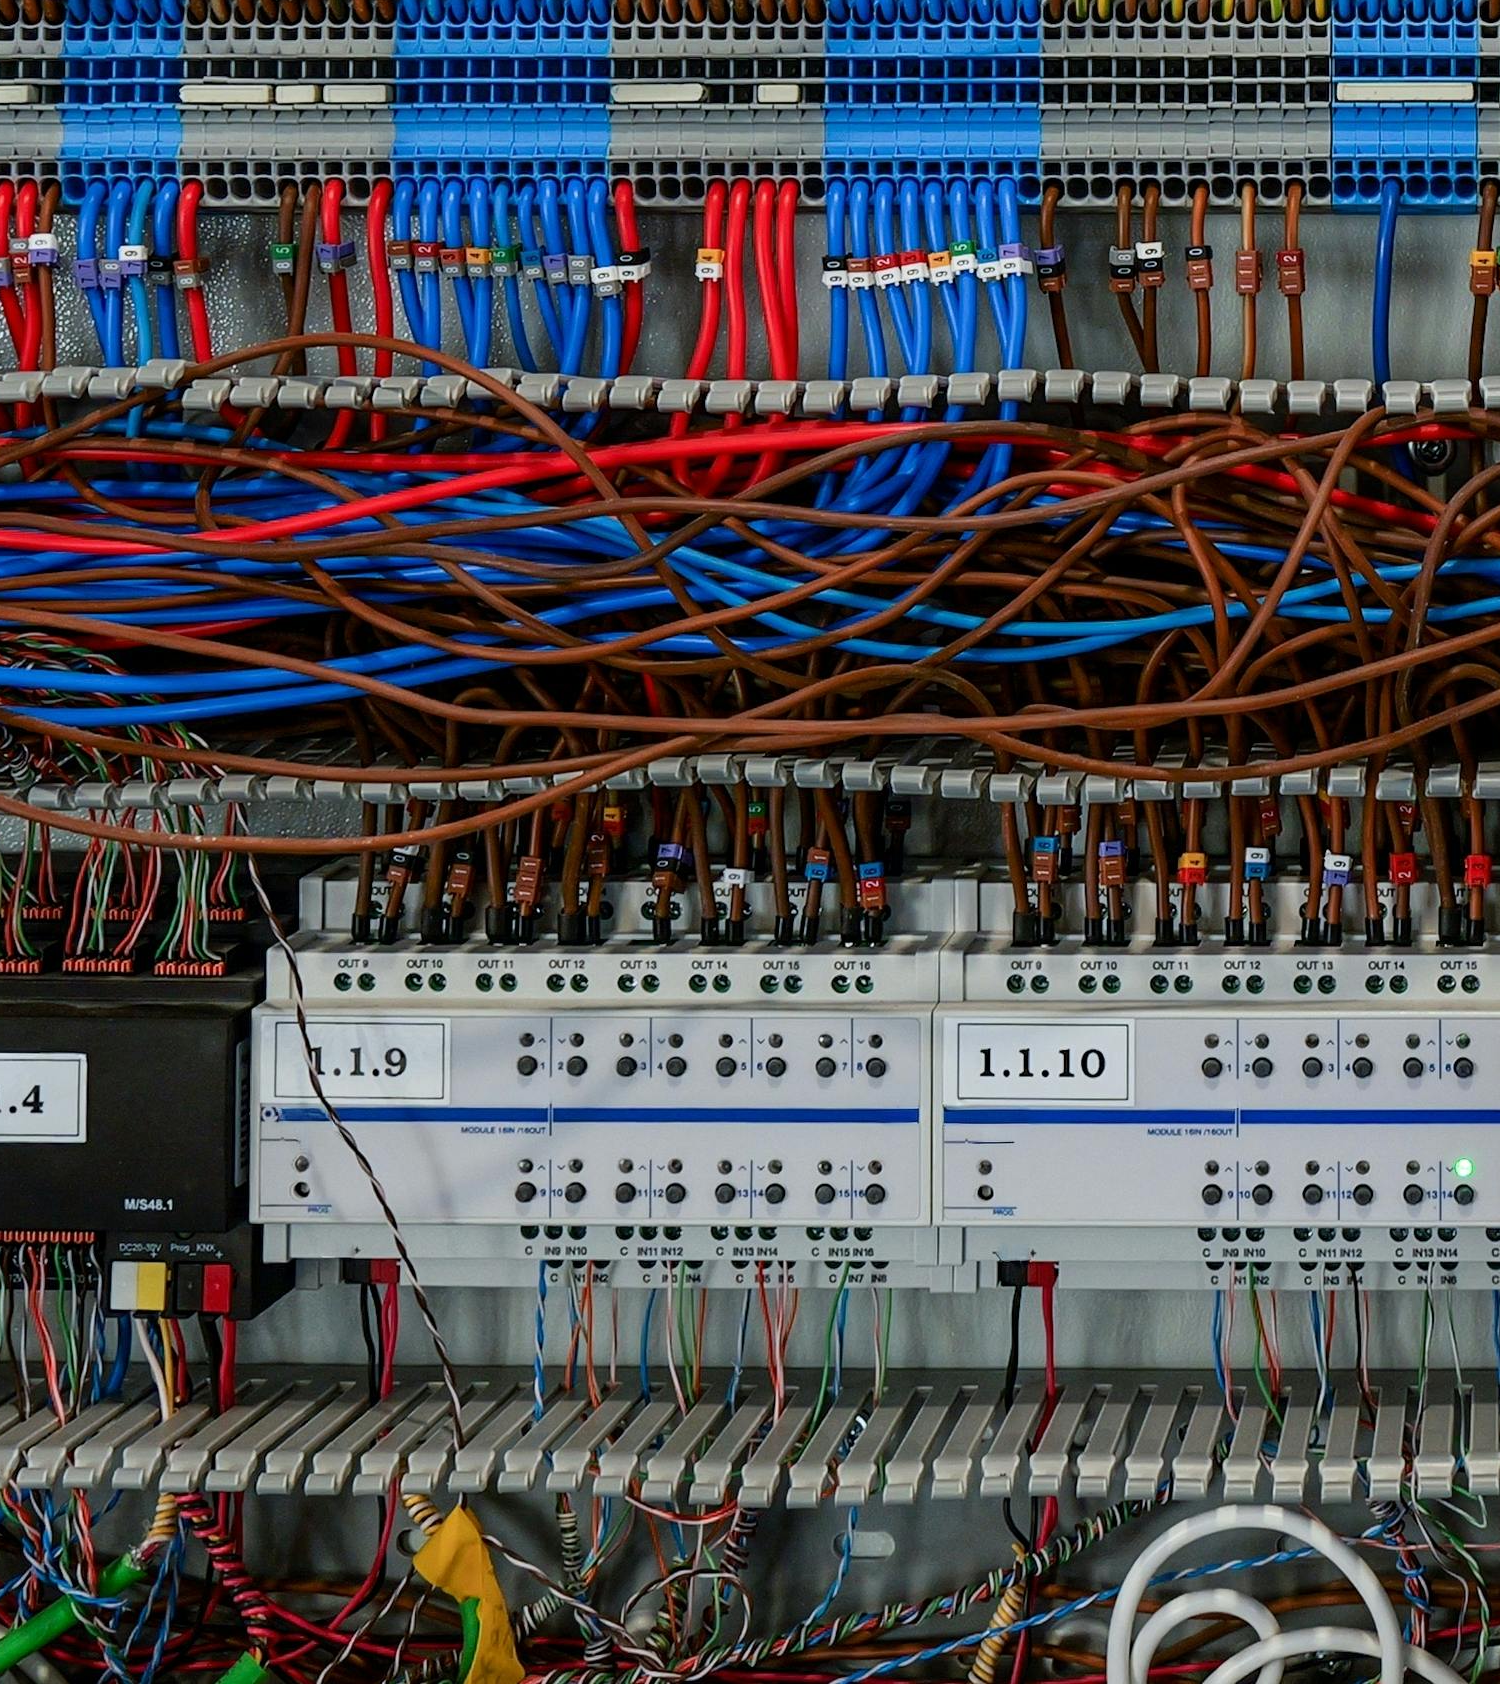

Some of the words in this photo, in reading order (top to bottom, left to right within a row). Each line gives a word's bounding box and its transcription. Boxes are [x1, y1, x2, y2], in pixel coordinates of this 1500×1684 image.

[338, 959, 360, 968] OUT
[363, 960, 369, 968] 9
[407, 959, 429, 968] OUT
[432, 959, 443, 968] 10
[478, 959, 500, 969] OUT
[504, 960, 513, 968] 11
[549, 959, 571, 969] OUT
[574, 960, 585, 969] 12
[620, 960, 643, 969] OUT
[646, 961, 657, 969] 13
[692, 961, 713, 969] OUT
[717, 961, 727, 969] 14
[763, 961, 785, 970] OUT
[788, 961, 800, 970] 15
[834, 961, 856, 970] OUT
[860, 961, 870, 970] 16
[1011, 961, 1033, 970] OUT
[1036, 961, 1041, 970] 9
[1081, 961, 1102, 970] OUT
[1106, 961, 1117, 970] 10
[1153, 961, 1175, 970] OUT
[1224, 961, 1246, 969] OUT
[1250, 961, 1260, 970] 12
[1297, 961, 1318, 970] OUT
[1322, 961, 1333, 970] 13
[1368, 961, 1391, 970] OUT
[1394, 961, 1404, 970] 14
[1440, 961, 1463, 970] OUT
[1466, 961, 1477, 970] 15
[309, 1047, 407, 1077] 1.1.9
[980, 1048, 1105, 1078] 1.1.10
[125, 1199, 172, 1210] M/S48.1
[545, 1247, 561, 1255] IN9
[566, 1247, 587, 1255] IN10
[638, 1248, 658, 1256] IN11
[661, 1248, 682, 1256] IN12
[733, 1248, 754, 1256] IN13
[757, 1248, 778, 1256] IN14
[828, 1248, 850, 1256] IN15
[852, 1248, 874, 1256] IN16
[1222, 1248, 1239, 1257] IN9
[1244, 1248, 1265, 1257] IN10
[1316, 1249, 1337, 1258] IN11
[1340, 1249, 1362, 1258] IN12
[1412, 1249, 1434, 1258] IN13
[1437, 1249, 1458, 1258] IN14
